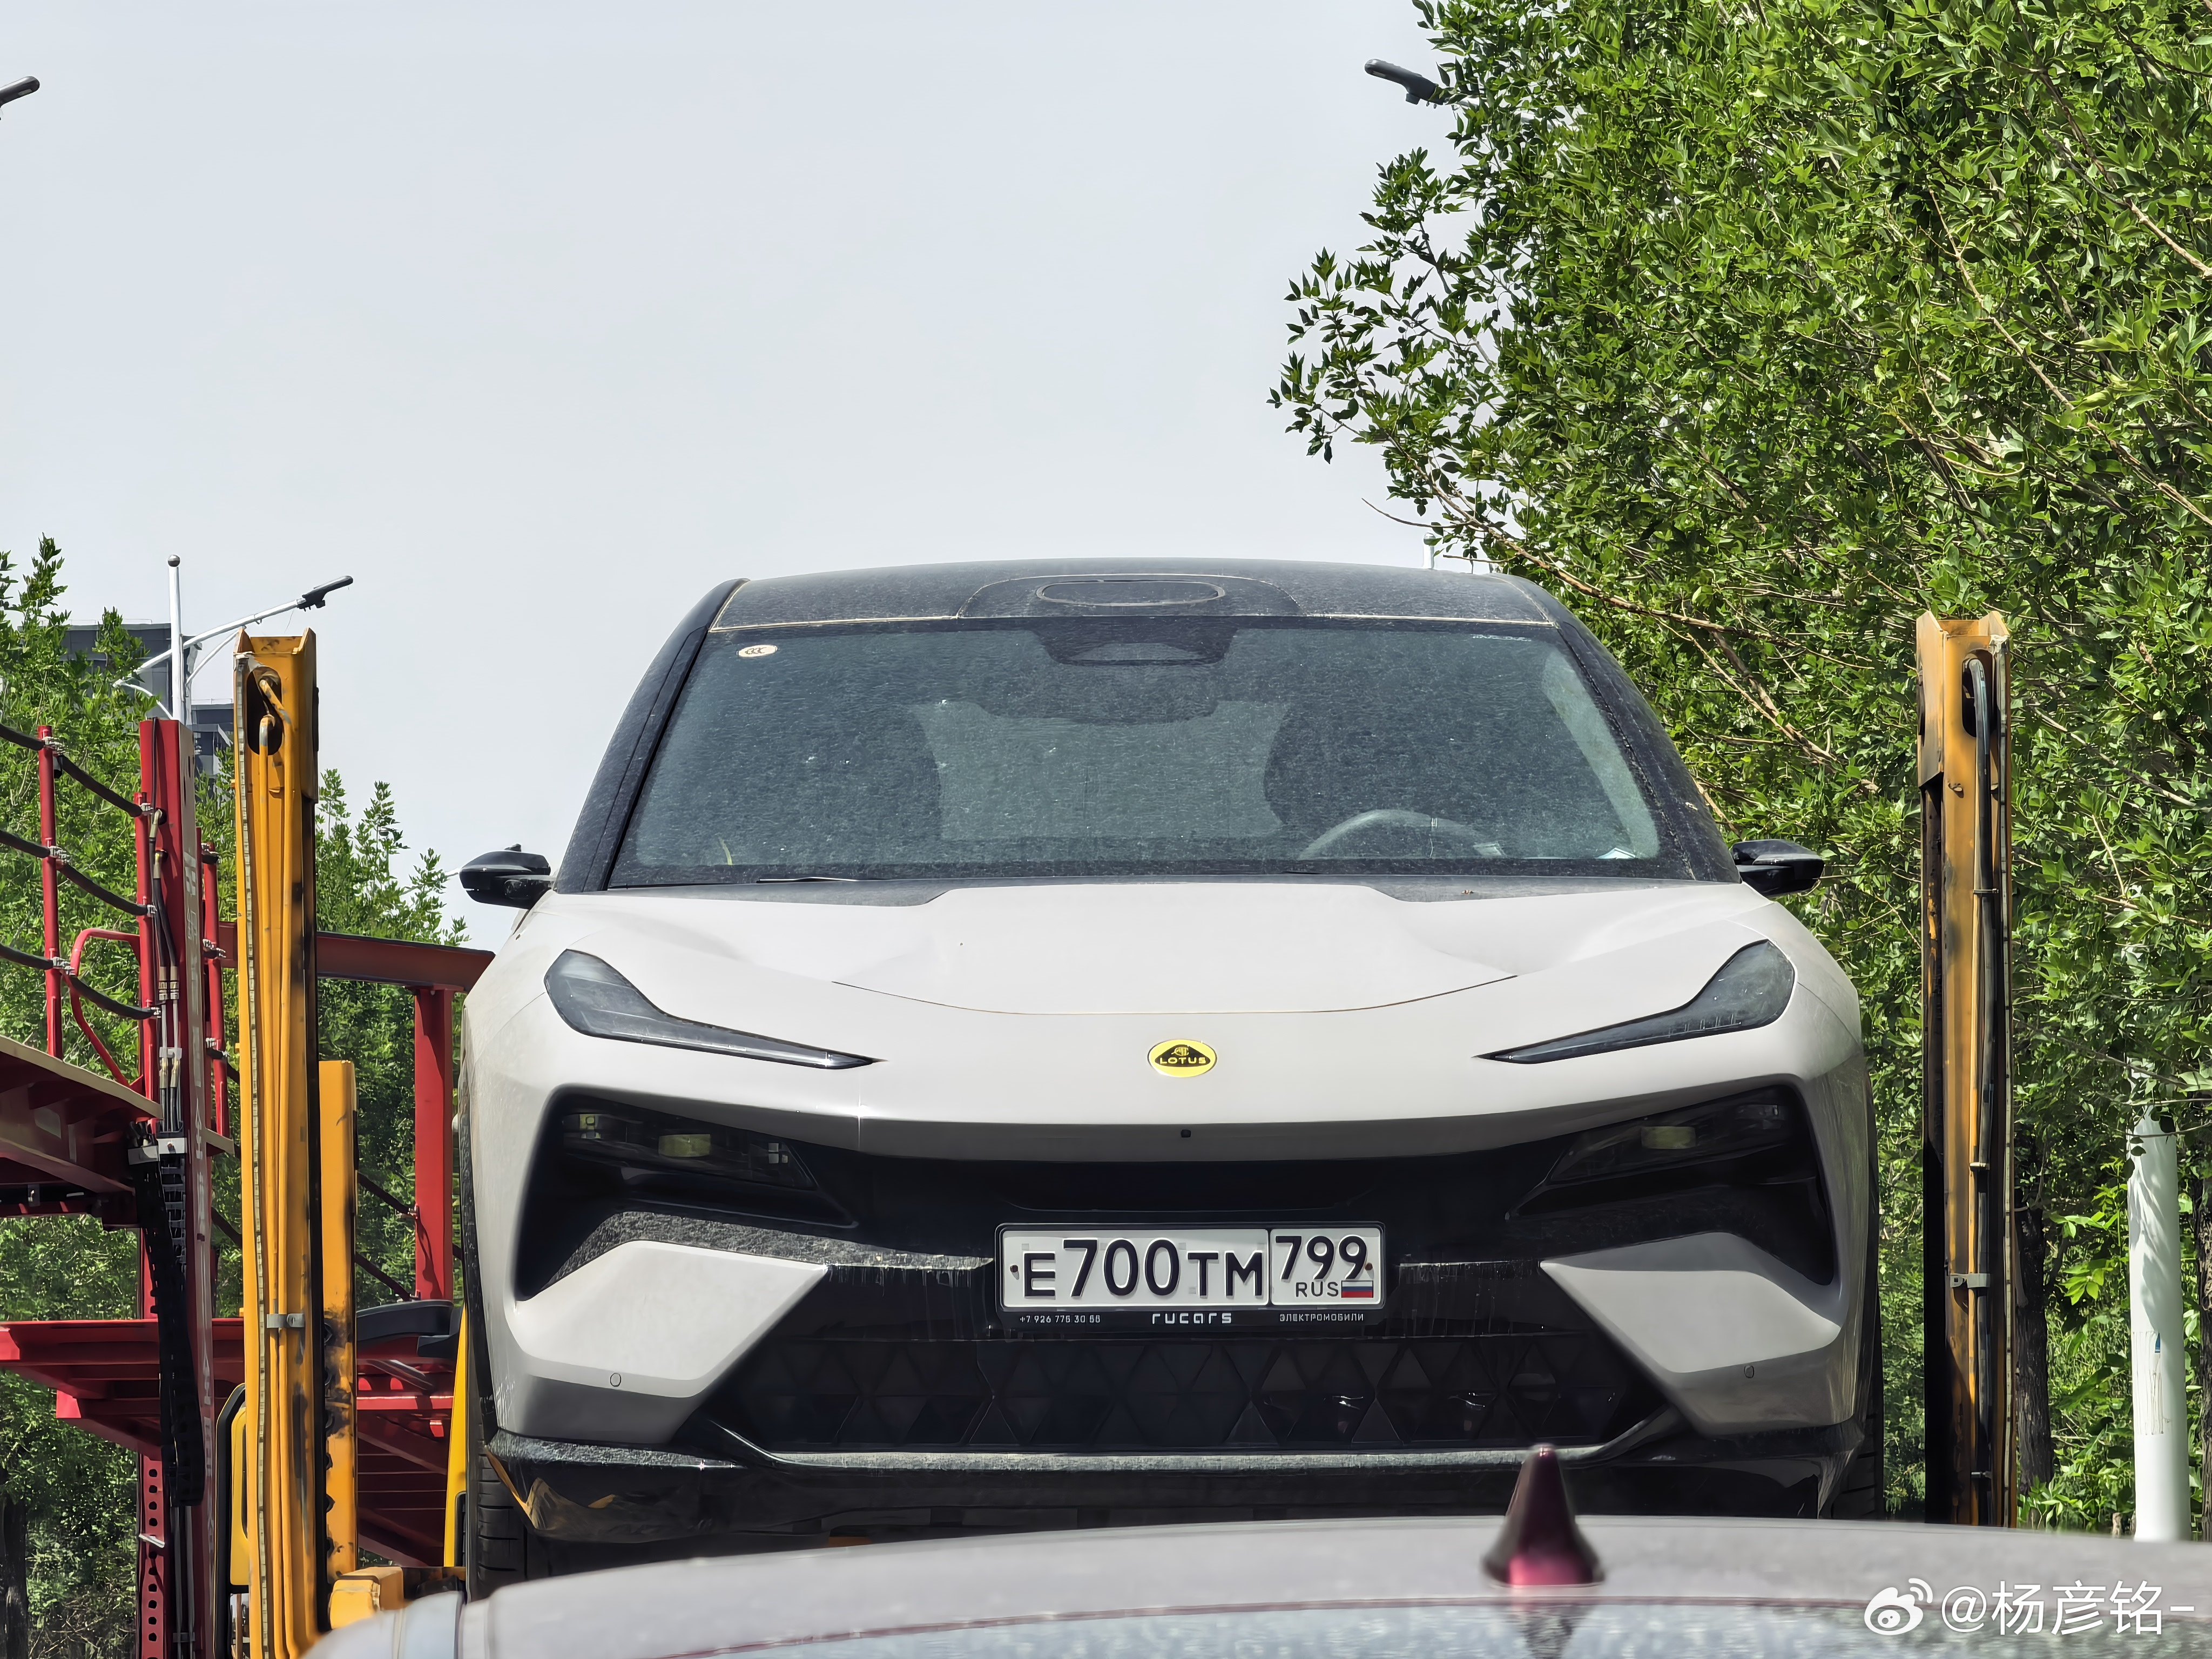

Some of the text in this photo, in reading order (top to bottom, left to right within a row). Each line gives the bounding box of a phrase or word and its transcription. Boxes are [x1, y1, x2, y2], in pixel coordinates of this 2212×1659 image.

[1024, 1235, 1367, 1297] E700TM 799
[1296, 1282, 1339, 1297] RUS
[1020, 1315, 1030, 1323] +7
[1034, 1315, 1051, 1323] 926
[1074, 1314, 1085, 1323] 30
[1152, 1313, 1231, 1324] rucars
[1279, 1313, 1364, 1321] ЭЛЕКТРОМОБИЛИ
